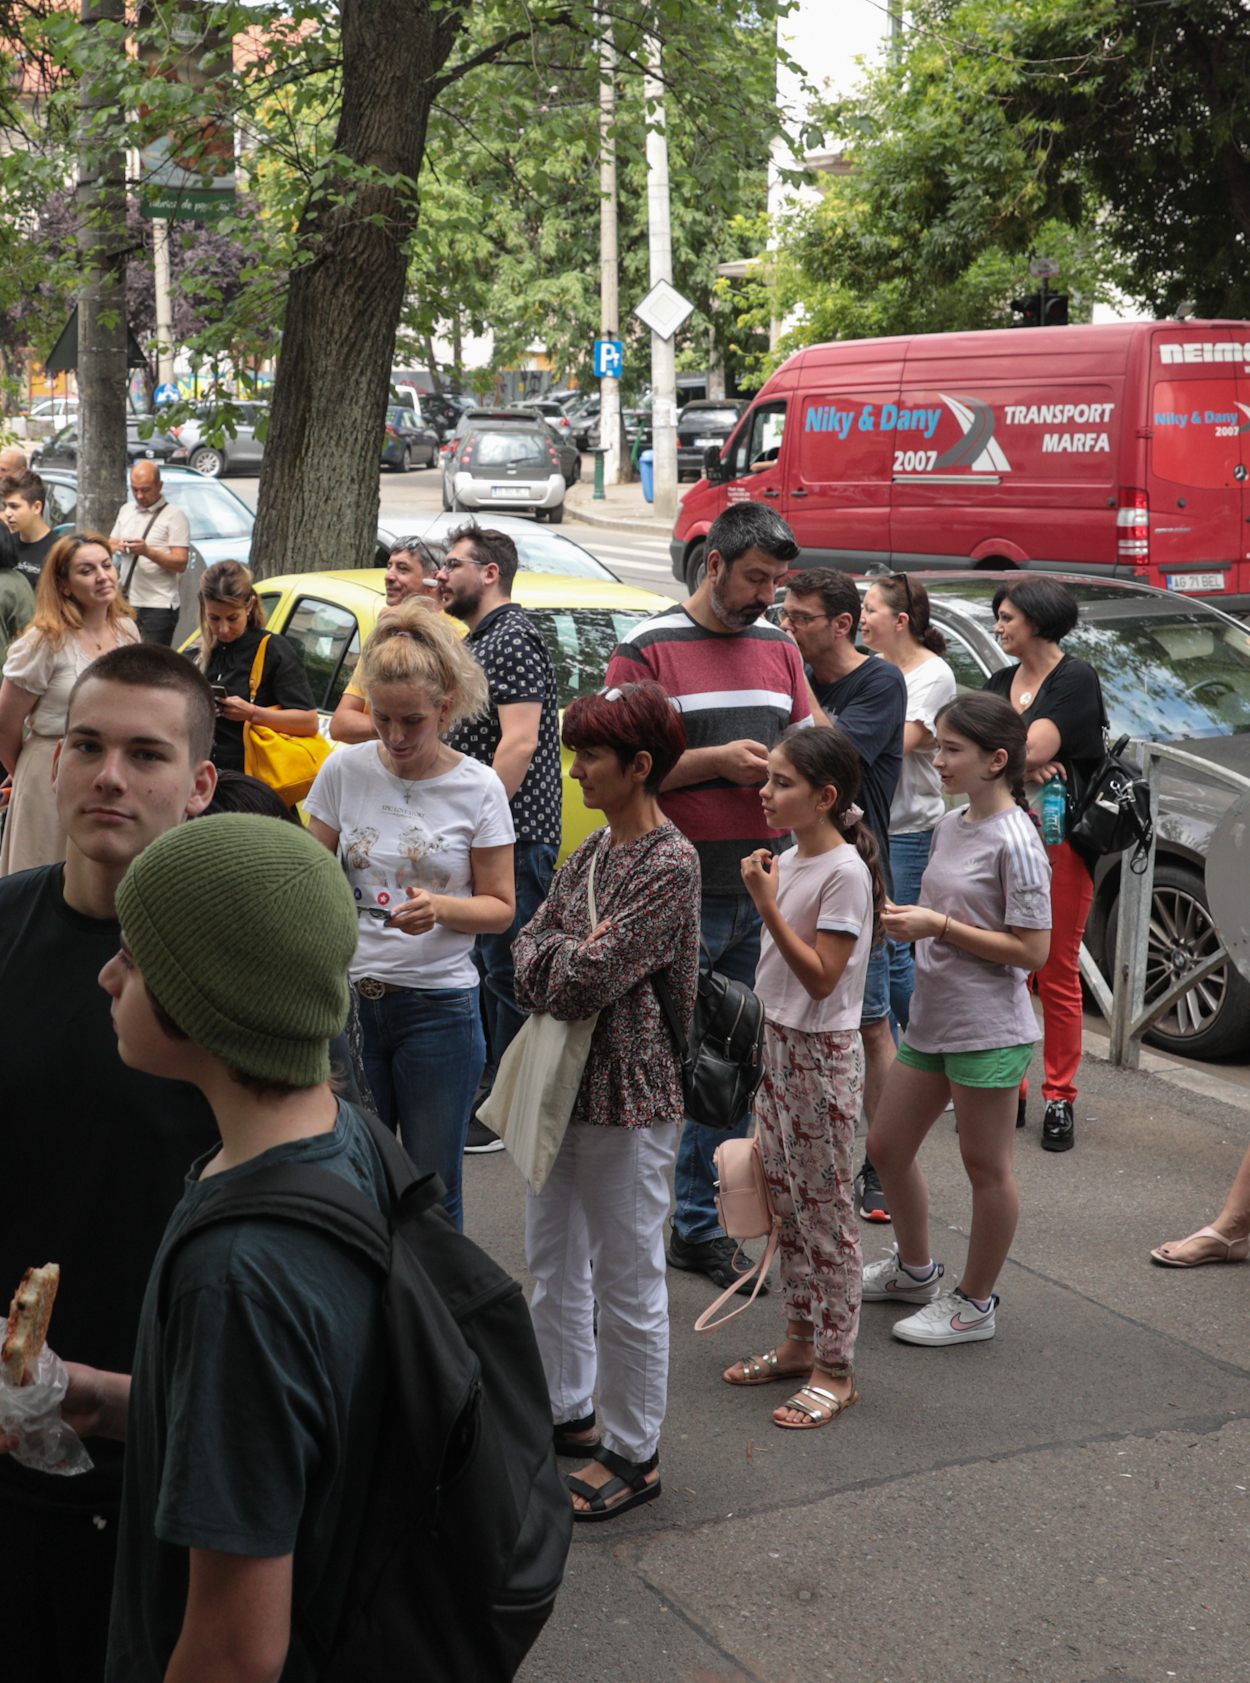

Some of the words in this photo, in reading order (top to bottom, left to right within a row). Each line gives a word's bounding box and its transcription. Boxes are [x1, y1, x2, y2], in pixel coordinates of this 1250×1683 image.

[600, 343, 617, 373] P
[1159, 342, 1250, 364] NEIM
[805, 406, 855, 439] Niky
[858, 404, 874, 431] &
[880, 404, 942, 438] Dany
[1004, 403, 1115, 425] TRANSPORT
[1154, 412, 1188, 428] Niky
[1191, 411, 1202, 424] &
[1204, 410, 1238, 427] Dany
[1215, 426, 1240, 437] 2007
[1042, 433, 1111, 452] MARFA
[892, 450, 938, 471] 2007
[1174, 576, 1187, 588] AG
[1189, 576, 1200, 588] 71
[1201, 575, 1221, 588] BEL
[394, 806, 408, 814] LOVE
[408, 810, 426, 818] STORY
